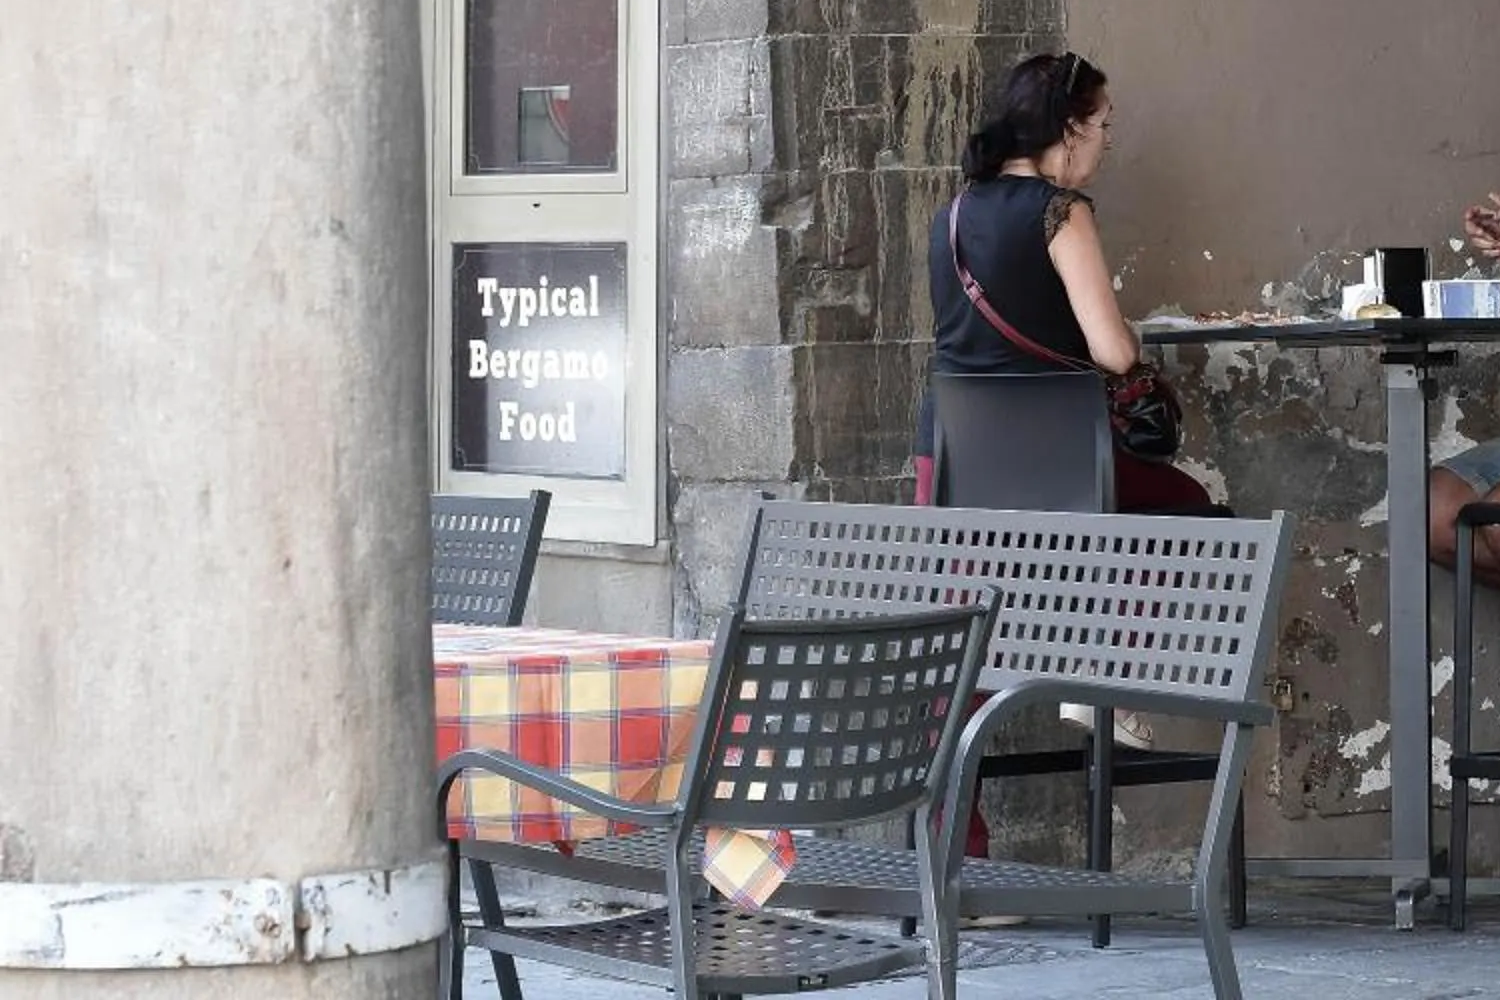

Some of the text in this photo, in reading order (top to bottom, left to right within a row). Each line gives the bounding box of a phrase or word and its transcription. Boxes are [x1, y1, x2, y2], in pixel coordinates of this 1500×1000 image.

[477, 275, 600, 328] Typical
[468, 339, 610, 389] Bergamo
[499, 401, 577, 442] Food
